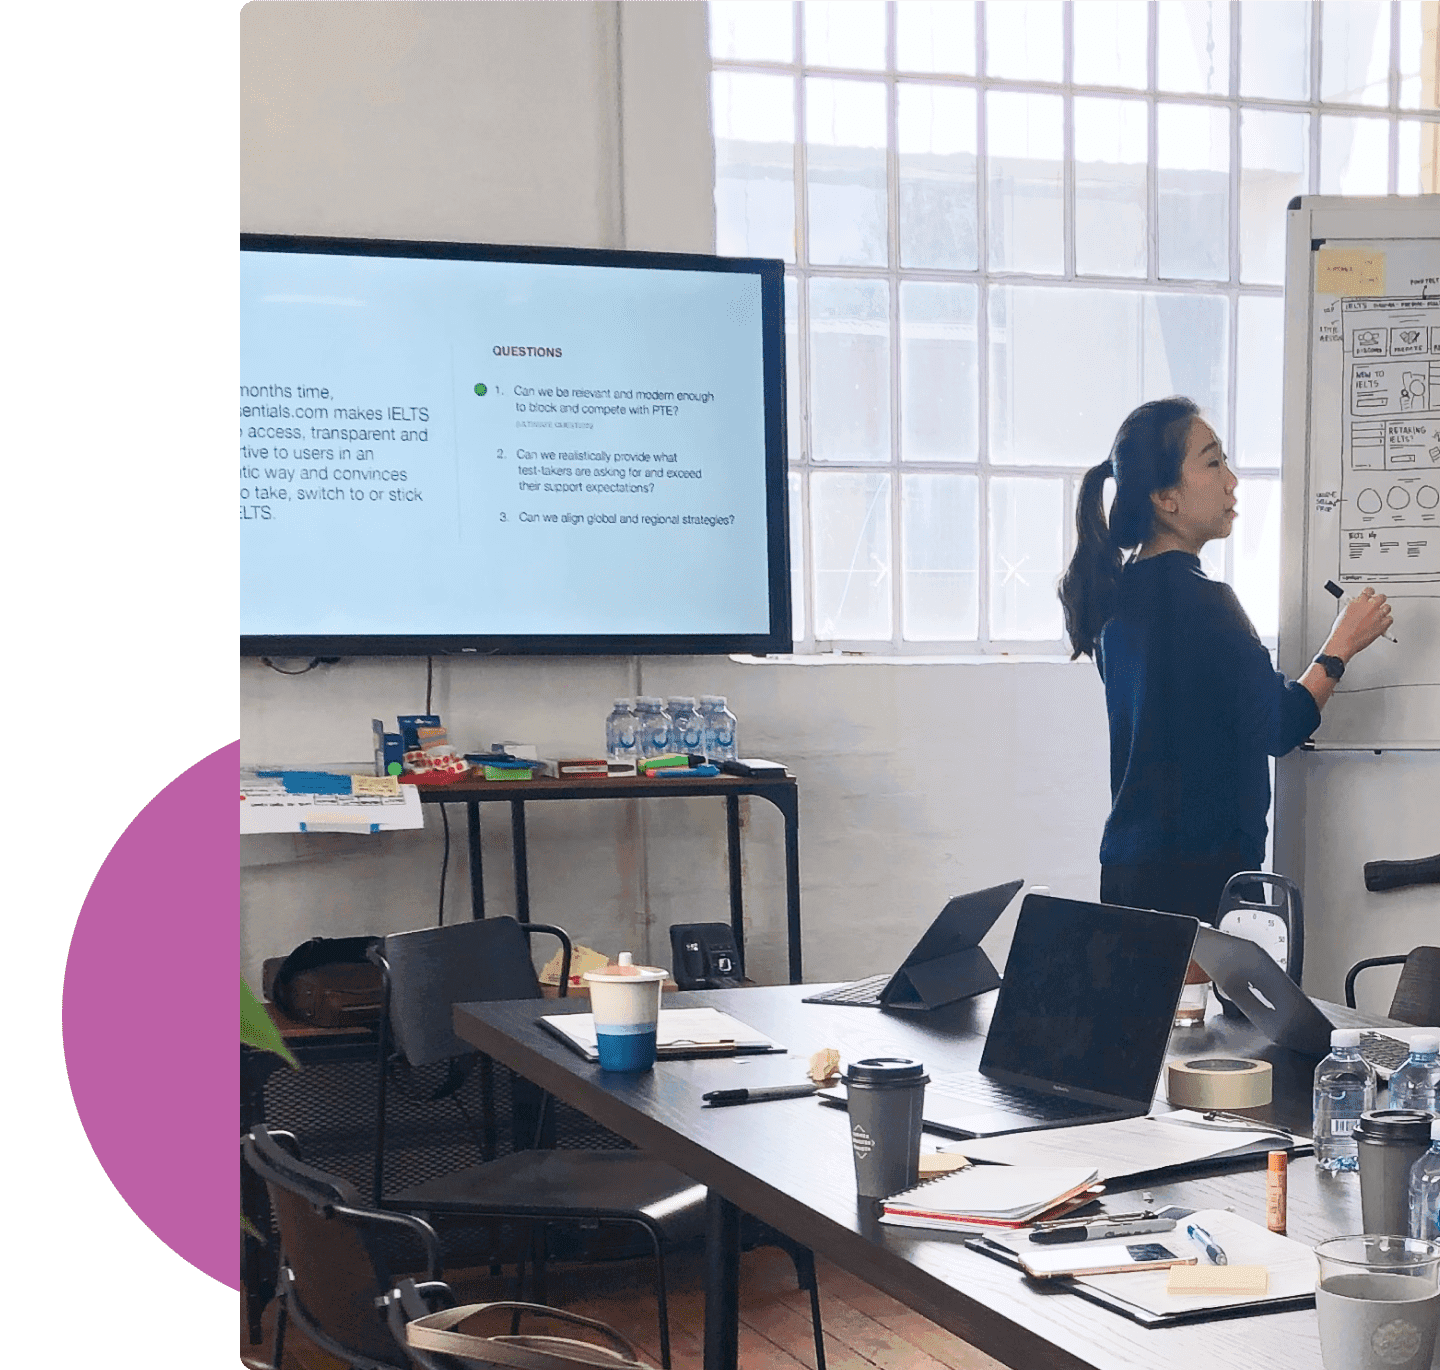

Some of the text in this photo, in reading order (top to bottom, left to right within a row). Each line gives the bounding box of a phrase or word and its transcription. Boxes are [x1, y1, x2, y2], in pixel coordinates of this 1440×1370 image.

[492, 345, 563, 358] QUESTIONS
[1356, 370, 1385, 379] NEW TO
[1356, 380, 1379, 389] IELTS
[297, 384, 334, 401] time,
[495, 386, 504, 396] 1.
[514, 385, 535, 397] Can
[538, 388, 554, 397] we
[556, 386, 569, 398] be
[572, 387, 611, 399] relevant
[613, 389, 633, 399] and
[677, 391, 715, 403] enough
[334, 406, 383, 420] makes
[387, 407, 430, 422] IELTS
[515, 402, 678, 417] to block and compete with PTE?
[248, 426, 306, 441] access,
[311, 426, 396, 442] transparent
[400, 428, 428, 441] and
[1389, 426, 1427, 435] RETAKING
[274, 446, 288, 459] to
[293, 449, 334, 460] users
[339, 446, 351, 460] in
[356, 449, 374, 460] an
[496, 449, 677, 463] 2. Can we realistically provide what
[240, 466, 408, 482] tic way and convinces
[518, 465, 703, 479] test-takers are asking for and exceed
[255, 486, 292, 501] take,
[297, 486, 345, 500] switch
[350, 488, 365, 500] to
[369, 490, 384, 500] or
[388, 488, 424, 501] stick
[519, 481, 655, 494] their support expectations?
[518, 512, 540, 523] Can
[542, 513, 558, 523] we
[561, 512, 584, 525] align
[587, 512, 617, 526] global
[620, 513, 639, 524] and
[641, 514, 680, 527] regional
[682, 514, 735, 527] strategies?
